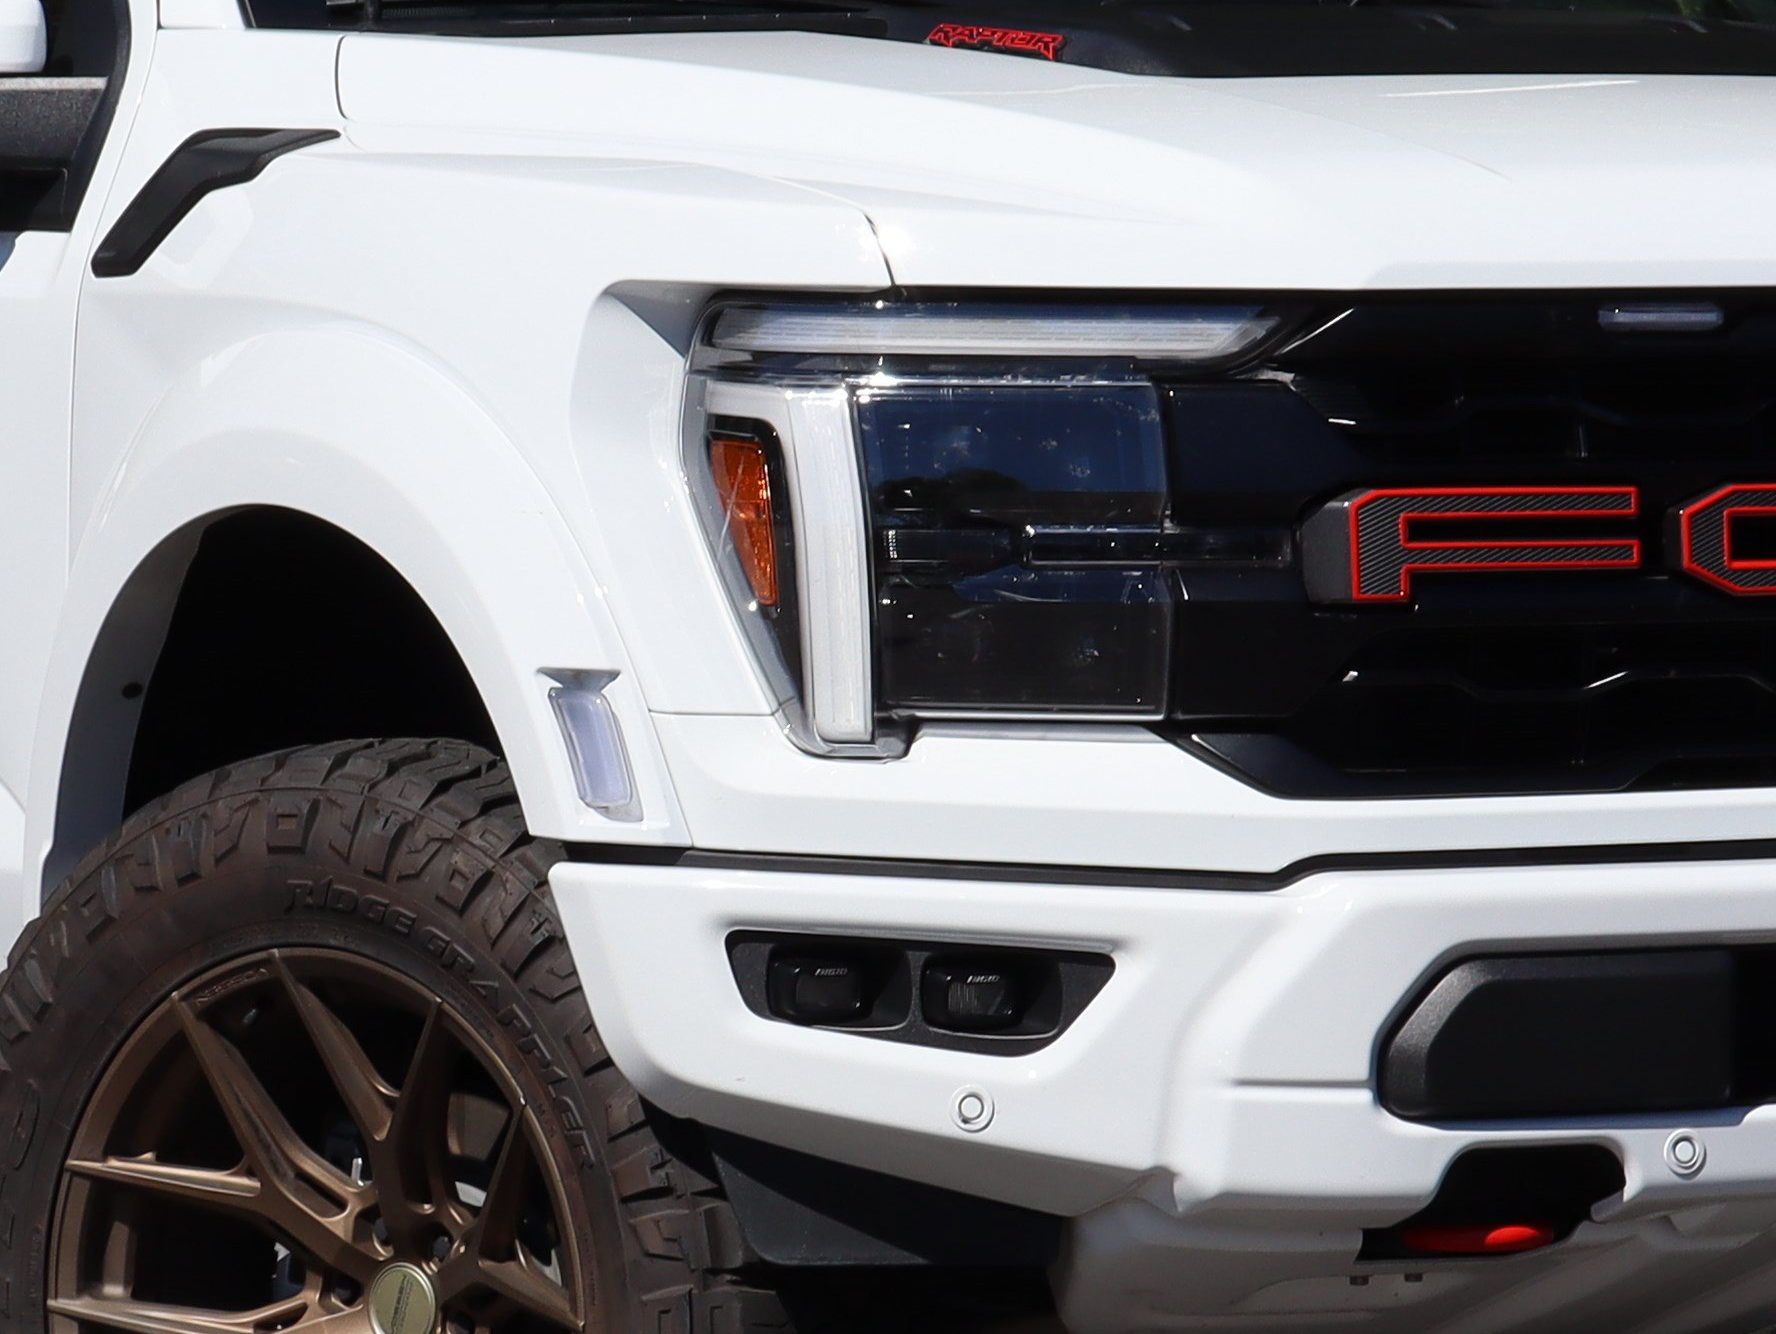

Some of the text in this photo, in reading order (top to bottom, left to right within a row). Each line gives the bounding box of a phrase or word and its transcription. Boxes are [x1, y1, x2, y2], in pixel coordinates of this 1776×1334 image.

[928, 23, 1065, 60] RAPTOR
[284, 875, 595, 1169] RIDGE GRAPPLER
